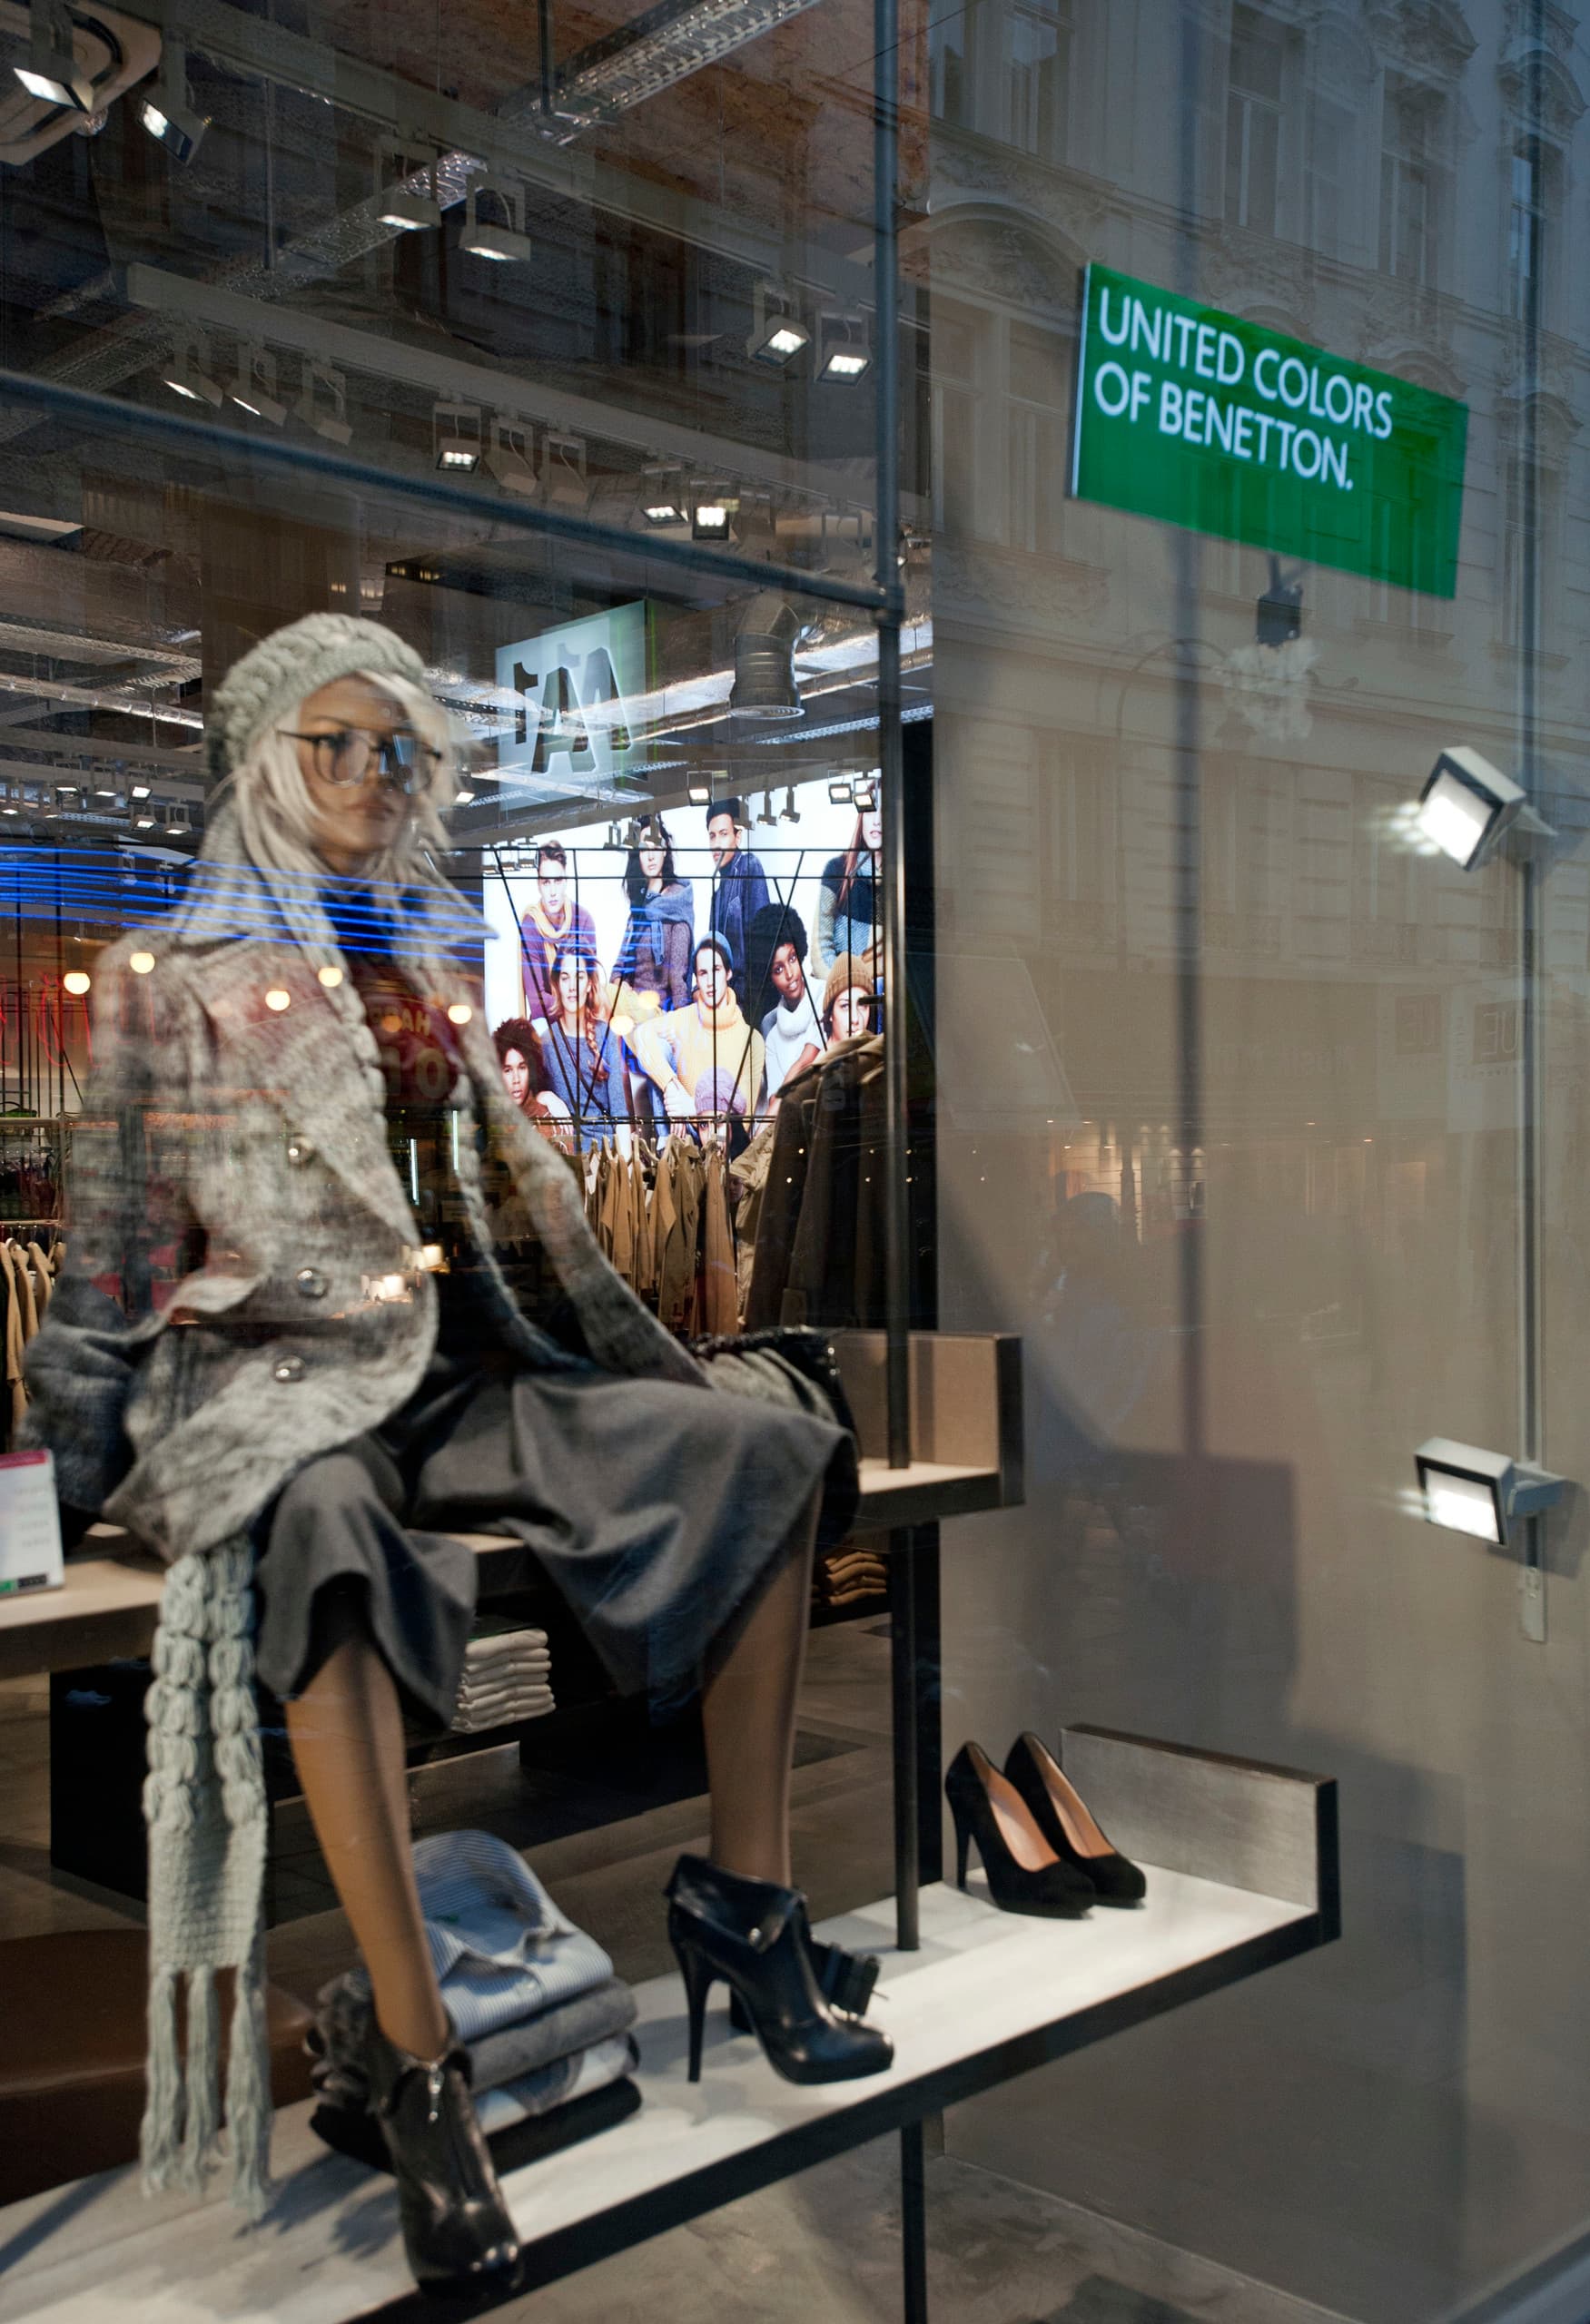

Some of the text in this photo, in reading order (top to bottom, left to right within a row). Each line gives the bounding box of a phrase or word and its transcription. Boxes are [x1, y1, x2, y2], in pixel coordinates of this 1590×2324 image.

[1093, 361, 1354, 490] OF BENETTON.
[1099, 287, 1393, 439] UNITED COLORS
